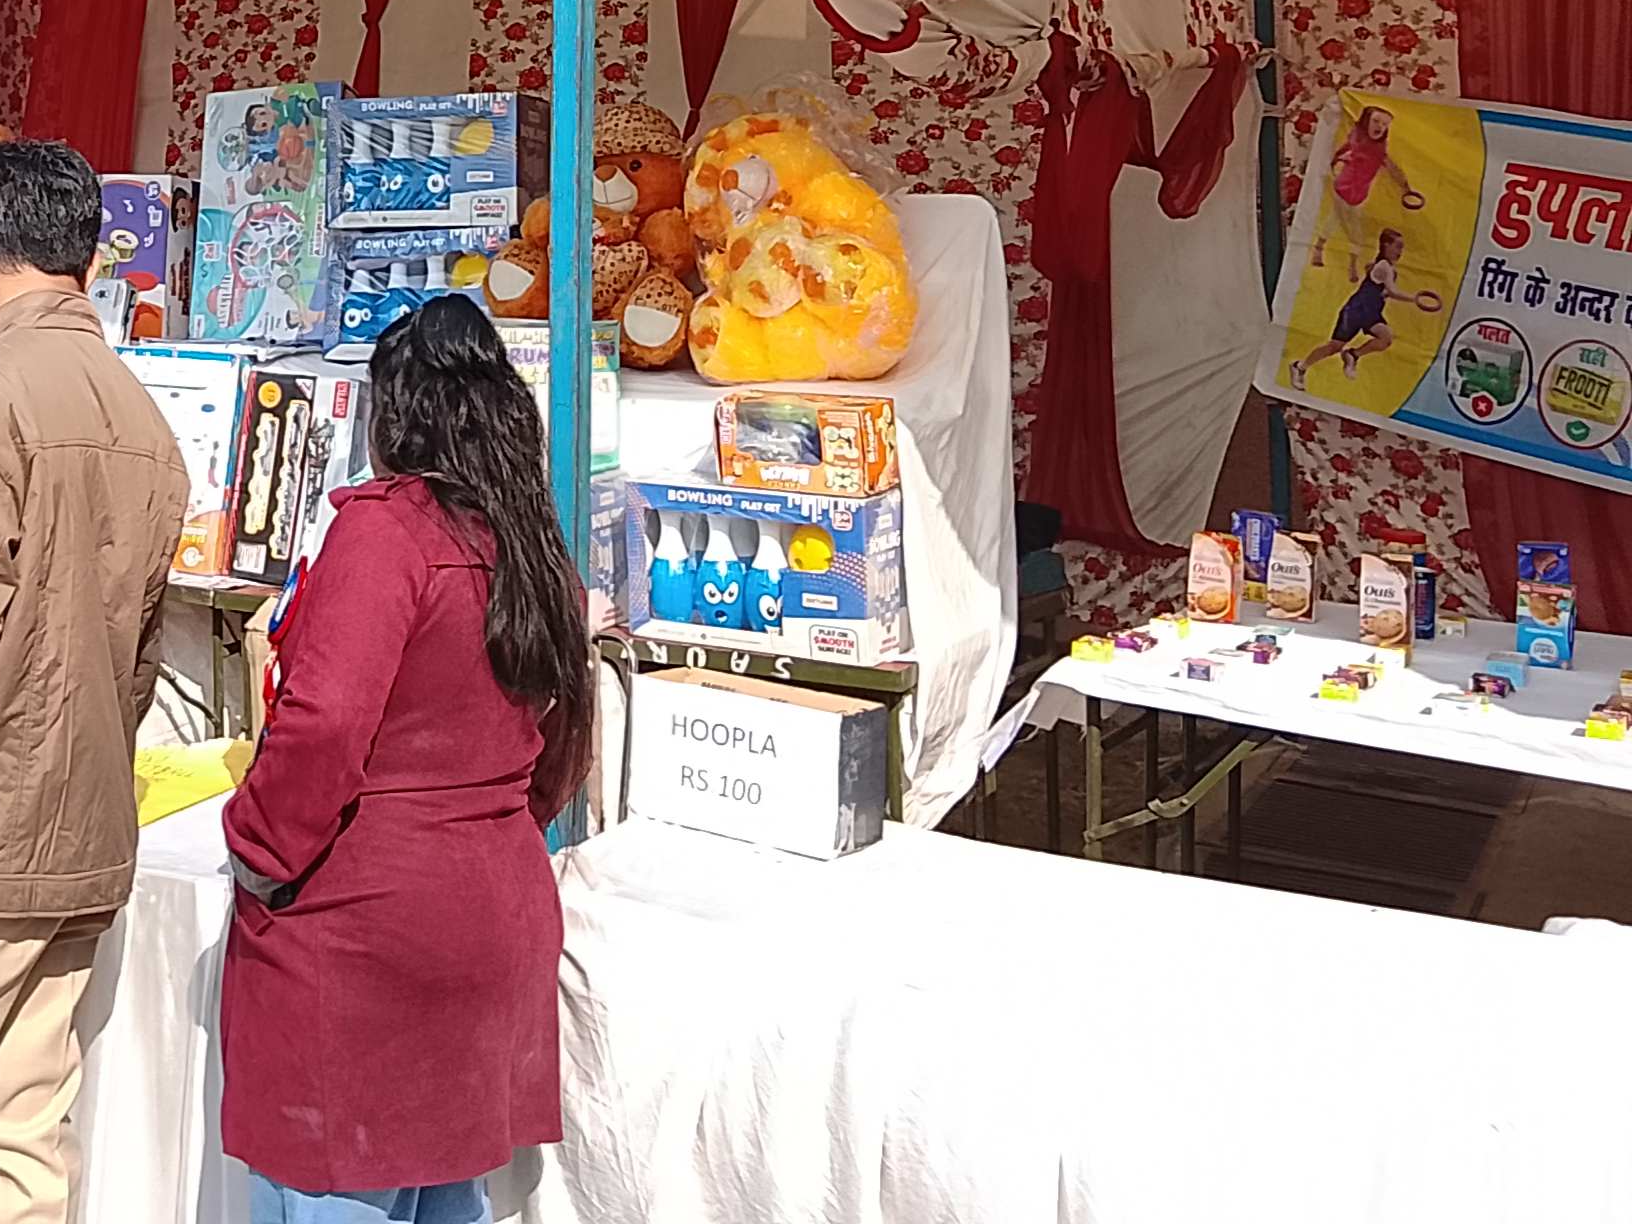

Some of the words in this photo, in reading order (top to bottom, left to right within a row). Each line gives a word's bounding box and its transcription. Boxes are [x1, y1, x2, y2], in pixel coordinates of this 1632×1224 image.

[360, 100, 414, 112] BOWLING
[355, 238, 408, 250] BOWLING
[1478, 256, 1519, 303] रिंग
[1524, 267, 1550, 308] के
[1555, 281, 1619, 325] अन्दर
[1476, 323, 1512, 345] गलत
[1555, 365, 1611, 406] FROOTI
[667, 488, 734, 507] BOWLING
[671, 714, 777, 758] HOOPLA
[681, 765, 709, 792] RS
[718, 775, 762, 805] 100
